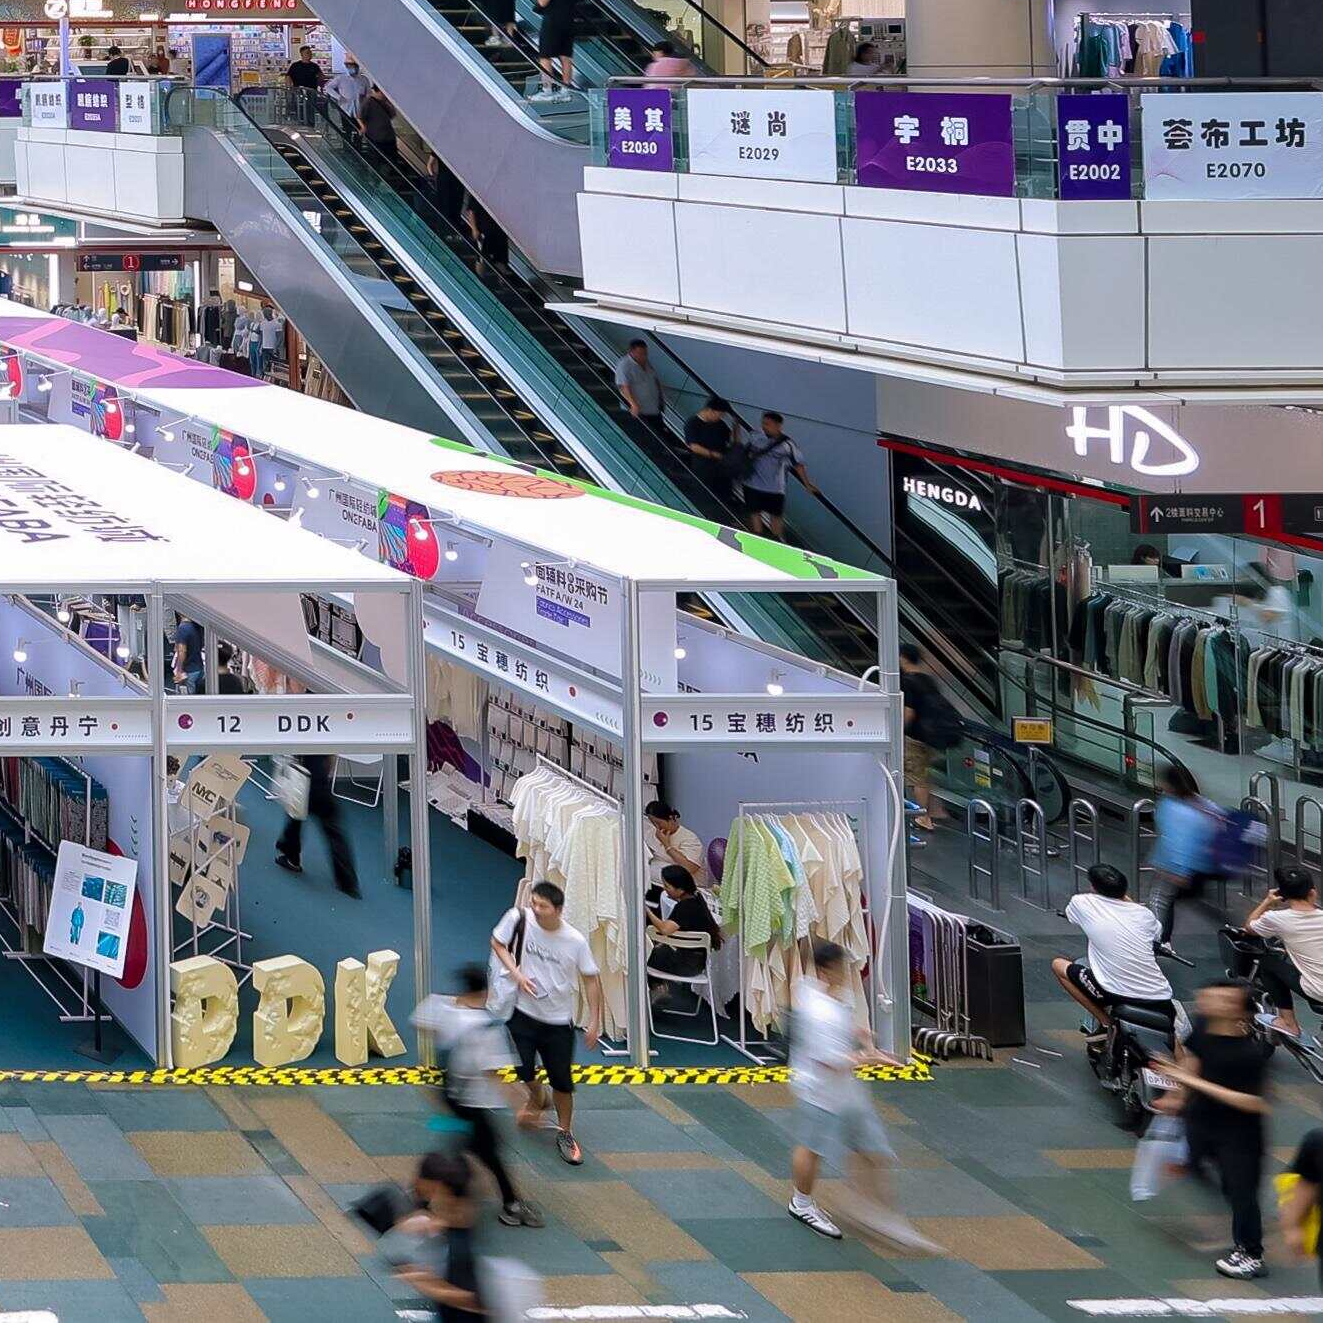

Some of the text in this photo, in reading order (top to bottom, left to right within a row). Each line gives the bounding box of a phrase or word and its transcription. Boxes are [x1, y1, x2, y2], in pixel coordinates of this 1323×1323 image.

[613, 107, 665, 133] 美其
[731, 111, 787, 138] 谜尚
[1065, 119, 1124, 152] 贯中
[1161, 118, 1307, 150] 荟布工坊
[621, 141, 658, 156] E2030
[738, 147, 780, 161] E2029
[906, 157, 958, 174] E2033
[1068, 165, 1122, 181] E2002
[1206, 163, 1267, 179] E2070
[1064, 405, 1201, 477] HD
[902, 476, 983, 513] HENGDA
[1252, 499, 1267, 528] 1
[450, 630, 551, 693] 15 宝穗纺织
[217, 715, 331, 733] 12 DDK
[689, 711, 835, 735] 15 宝穗纺织
[169, 949, 408, 1068] DDK
